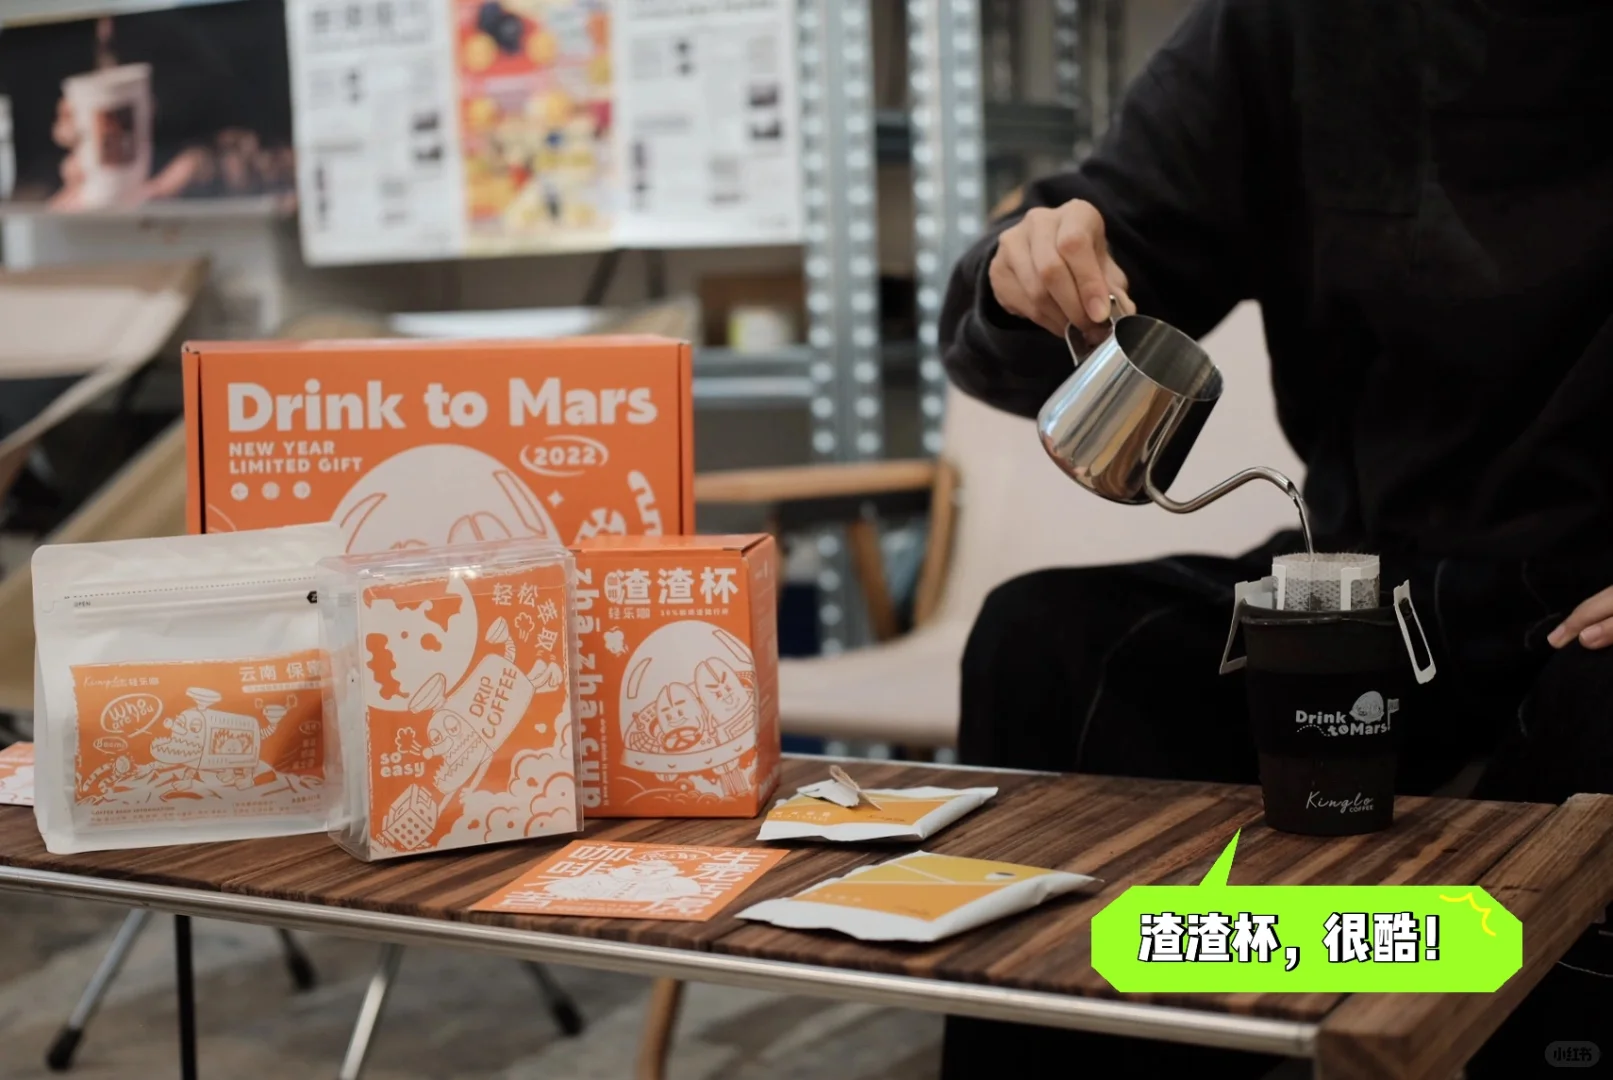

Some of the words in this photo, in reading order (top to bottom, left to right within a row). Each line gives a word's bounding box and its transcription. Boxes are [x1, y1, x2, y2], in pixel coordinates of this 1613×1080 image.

[228, 378, 406, 432] Drink
[423, 383, 488, 428] to
[508, 377, 658, 426] Mars
[229, 442, 275, 457] NEW
[283, 440, 336, 456] YEAR
[533, 446, 597, 466] 2022
[229, 458, 311, 475] LIMITED
[318, 456, 363, 472] GIFT
[615, 567, 739, 605] 渣渣杯
[239, 665, 277, 682] 云南
[469, 676, 494, 718] DRIP
[481, 667, 517, 739] COFFEE
[1296, 710, 1347, 724] Drink
[1327, 725, 1349, 737] to
[1350, 722, 1387, 736] Mars
[379, 752, 402, 764] so
[380, 761, 425, 778] easy
[1305, 791, 1374, 814] Kinglo
[1349, 804, 1374, 813] COFFEE
